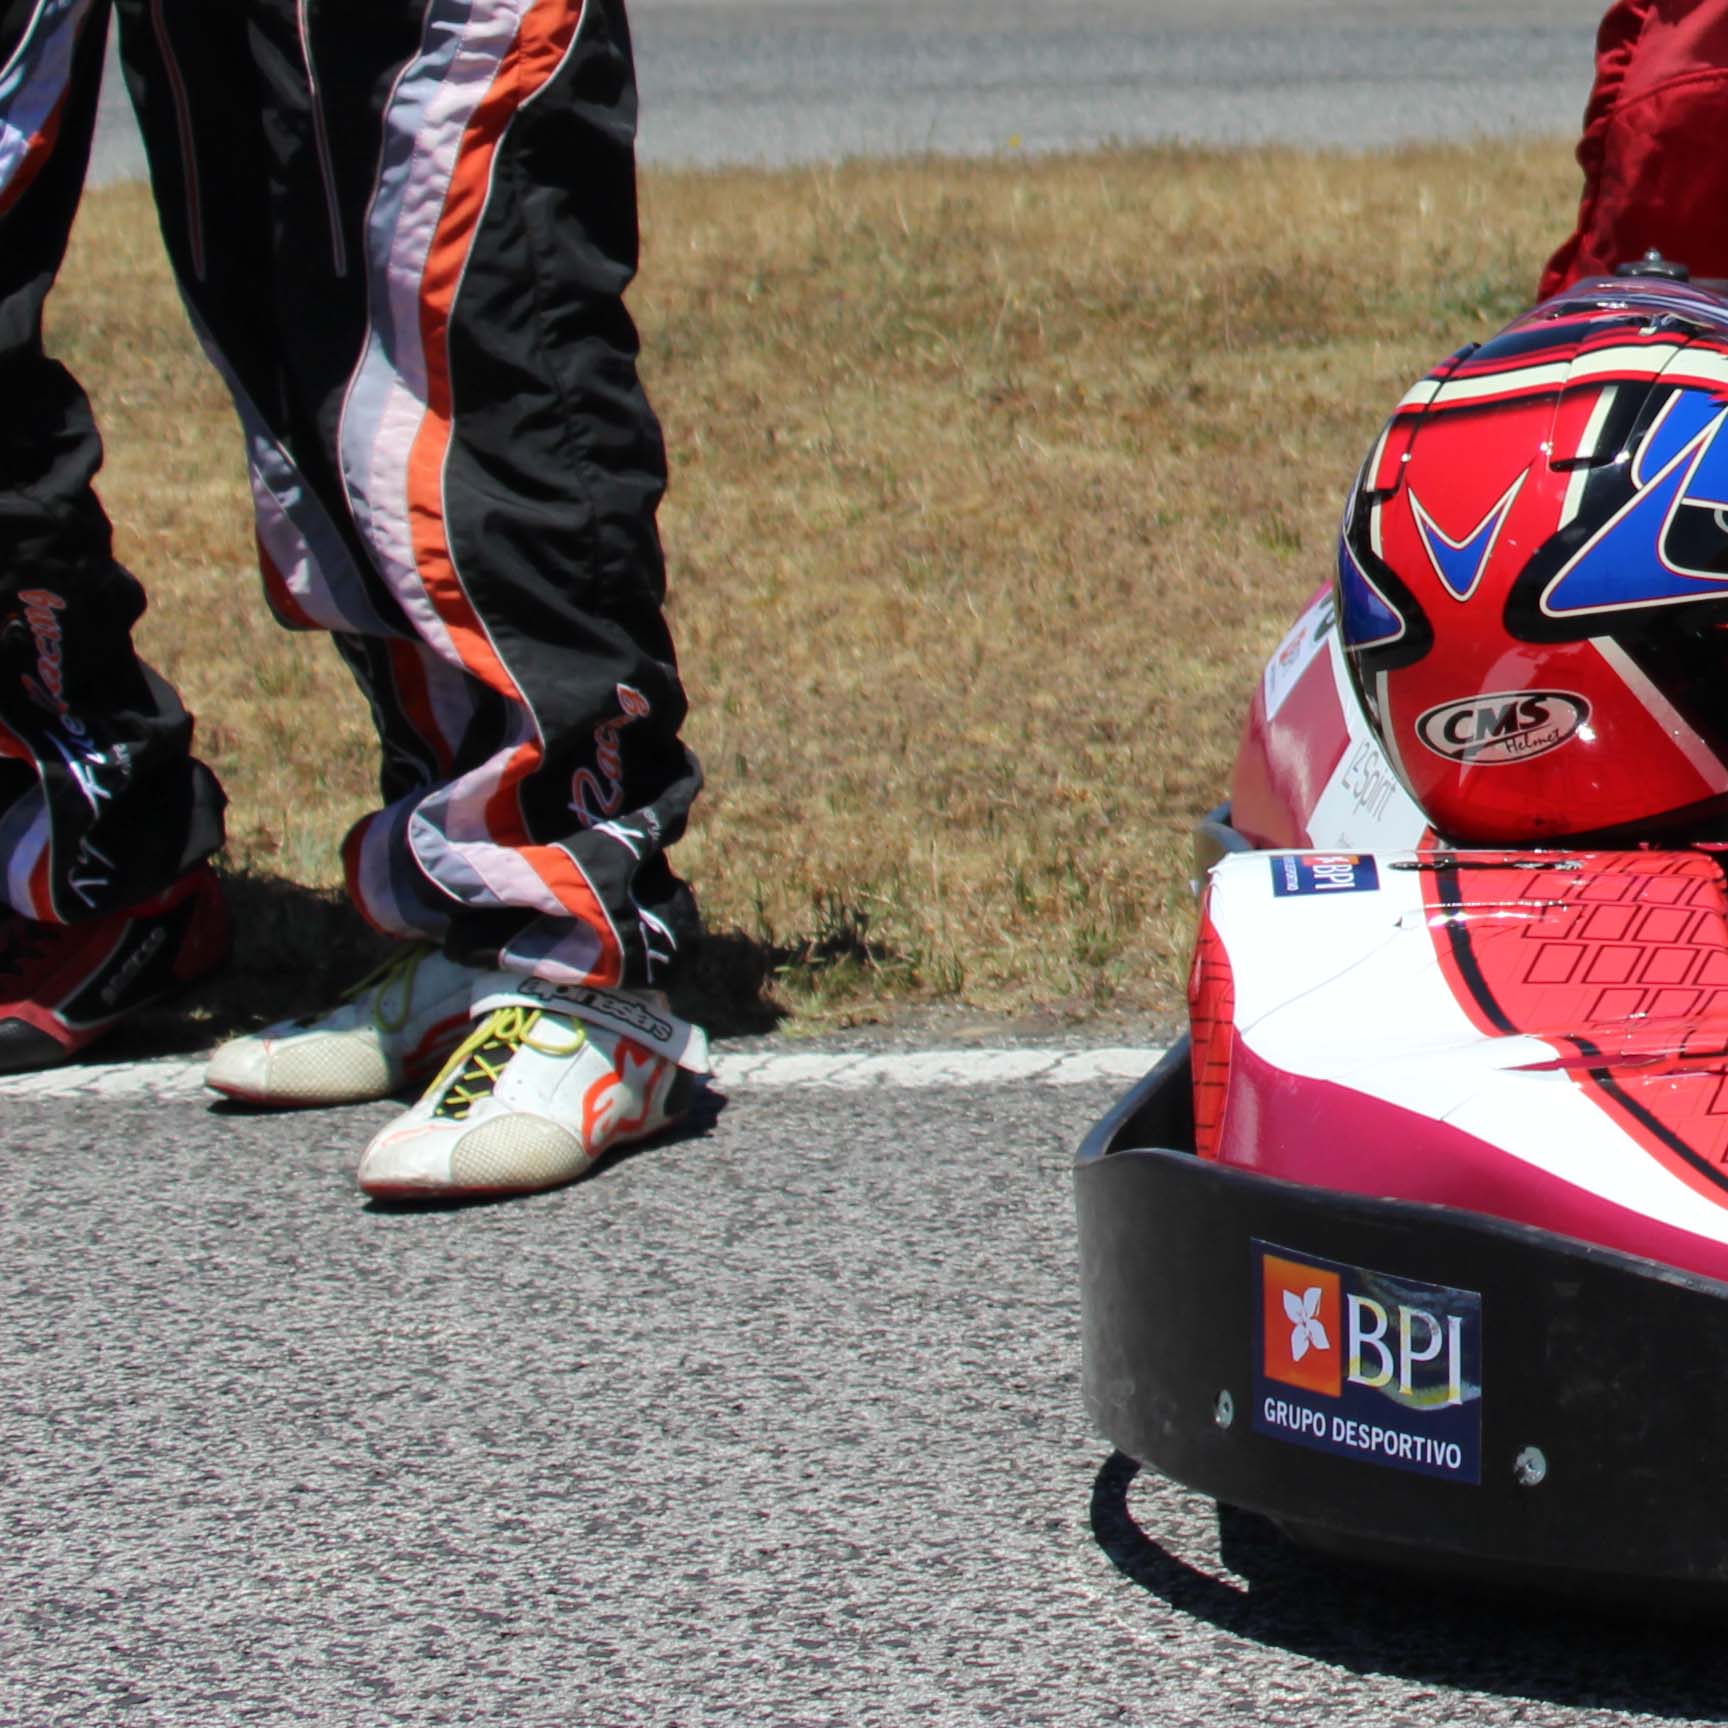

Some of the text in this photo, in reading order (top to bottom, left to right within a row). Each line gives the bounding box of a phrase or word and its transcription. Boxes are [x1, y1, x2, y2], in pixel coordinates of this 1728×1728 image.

[1443, 696, 1550, 745] CMS
[1504, 728, 1563, 755] Helmet
[1312, 864, 1355, 890] BPI
[1346, 1293, 1463, 1405] BPI
[1264, 1398, 1462, 1468] GRUPO DESPORTIVO
